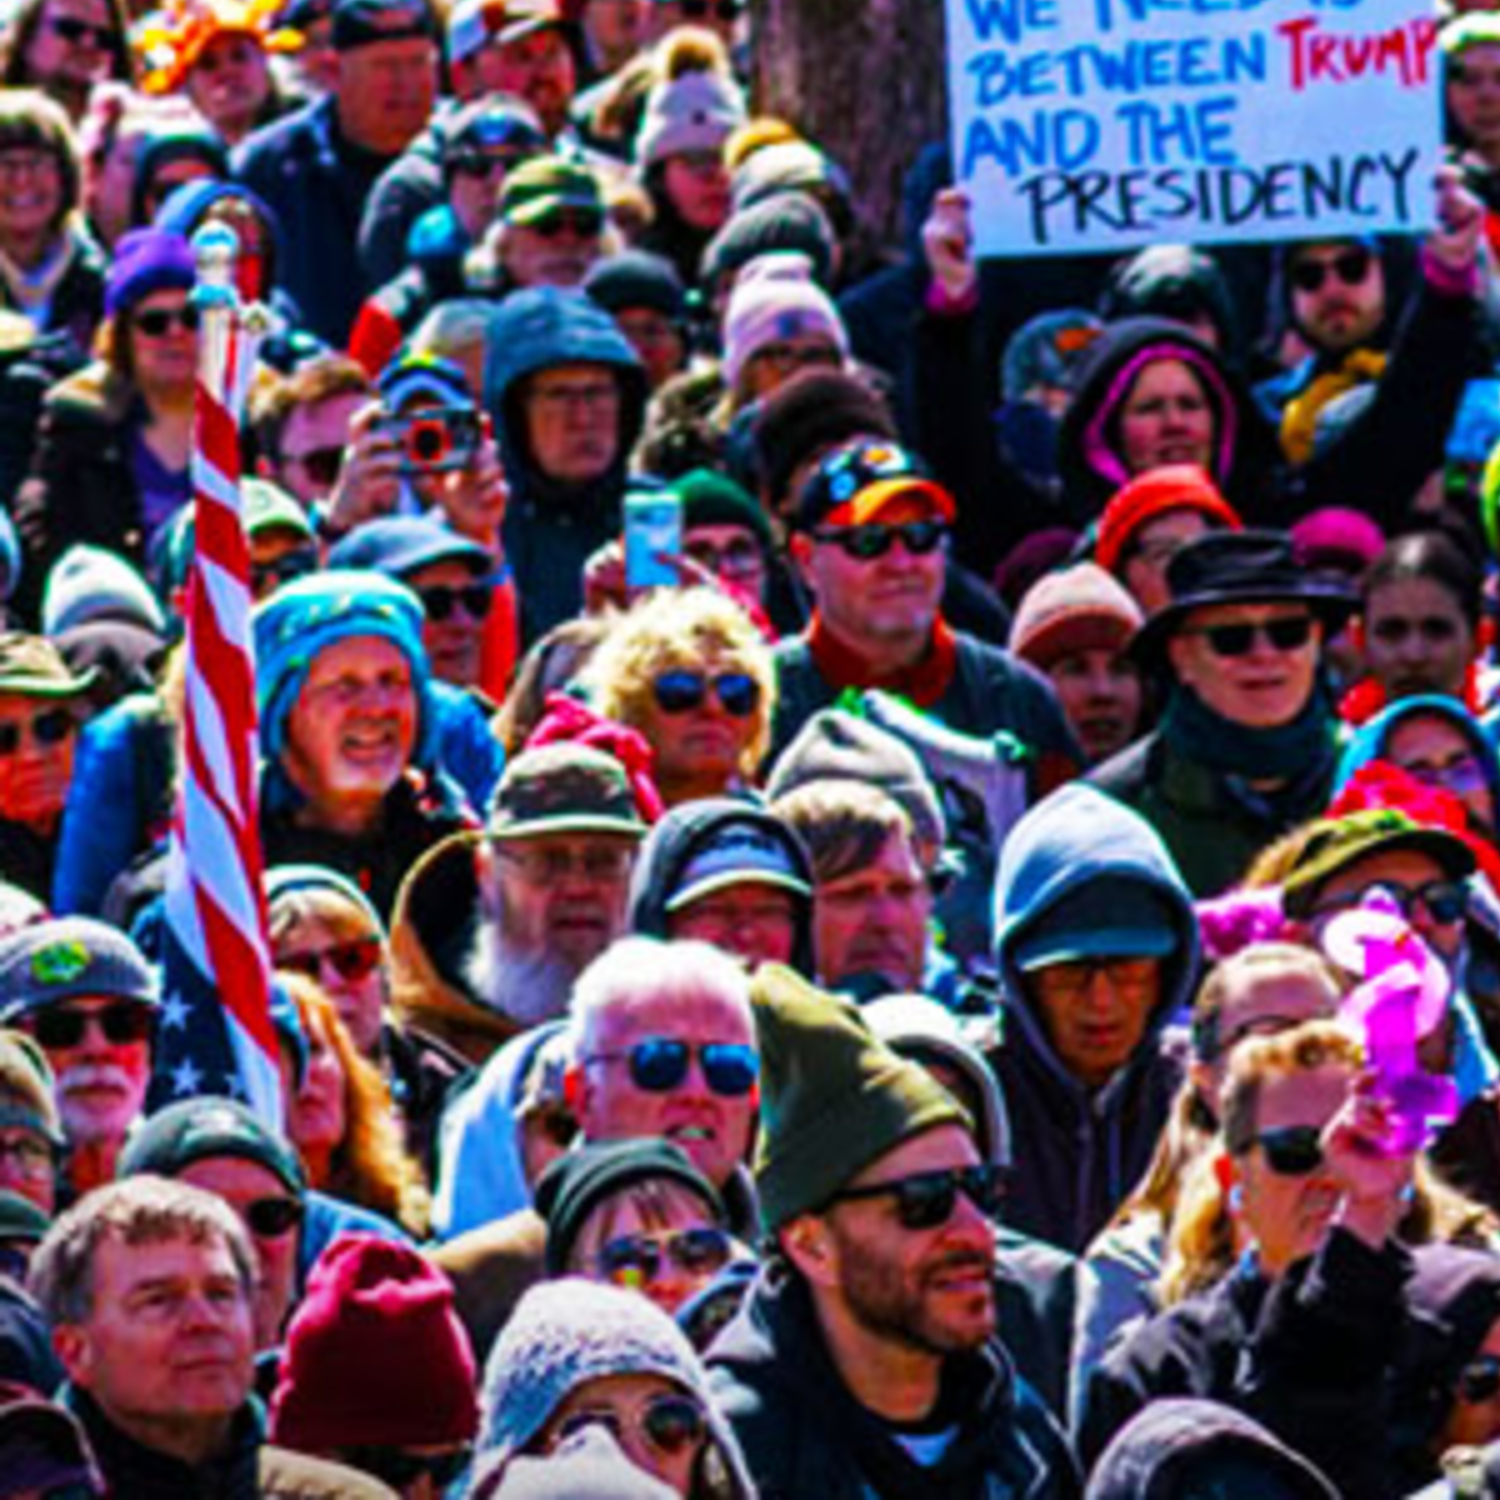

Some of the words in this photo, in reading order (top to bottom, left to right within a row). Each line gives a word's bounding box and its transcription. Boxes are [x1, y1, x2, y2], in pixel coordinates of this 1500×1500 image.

[965, 31, 1266, 109] BETWEEN
[1277, 16, 1437, 91] TRUMP
[960, 108, 1100, 180] AND
[1116, 96, 1238, 166] THE
[1016, 146, 1418, 245] PRESIDENCY
